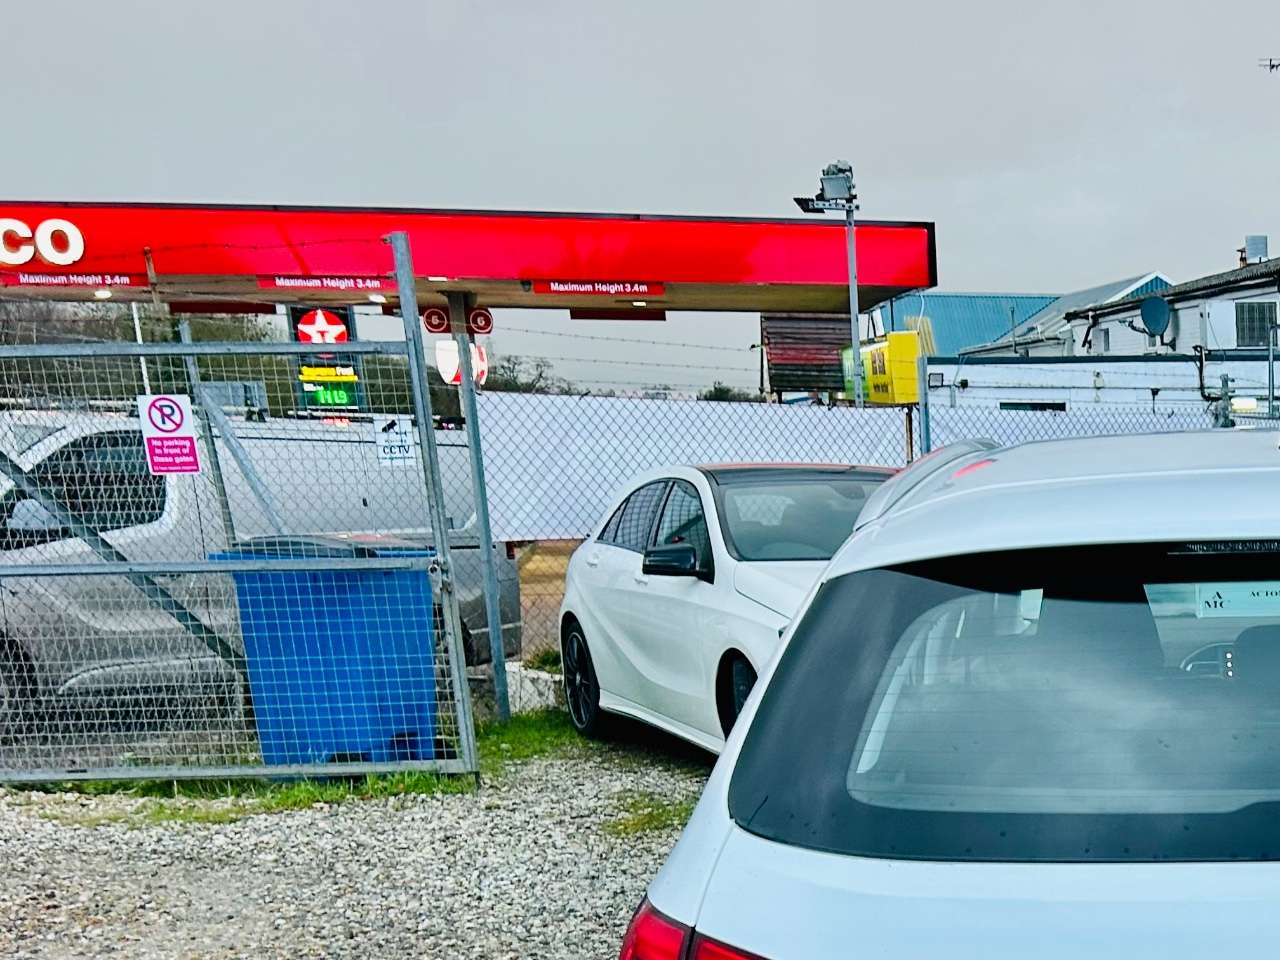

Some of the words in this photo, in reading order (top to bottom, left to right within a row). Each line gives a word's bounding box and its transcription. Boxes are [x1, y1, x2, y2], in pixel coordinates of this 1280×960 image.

[20, 273, 67, 284] Maximum
[69, 274, 102, 285] Height
[105, 275, 130, 285] 3.4m
[275, 277, 320, 287] Maximum
[323, 278, 354, 289] Height
[356, 278, 381, 288] 3.4m
[550, 282, 592, 292] Maximum
[595, 283, 624, 293] Height
[625, 283, 647, 292] 3.4m
[163, 439, 190, 448] parking
[383, 445, 410, 455] CCTV
